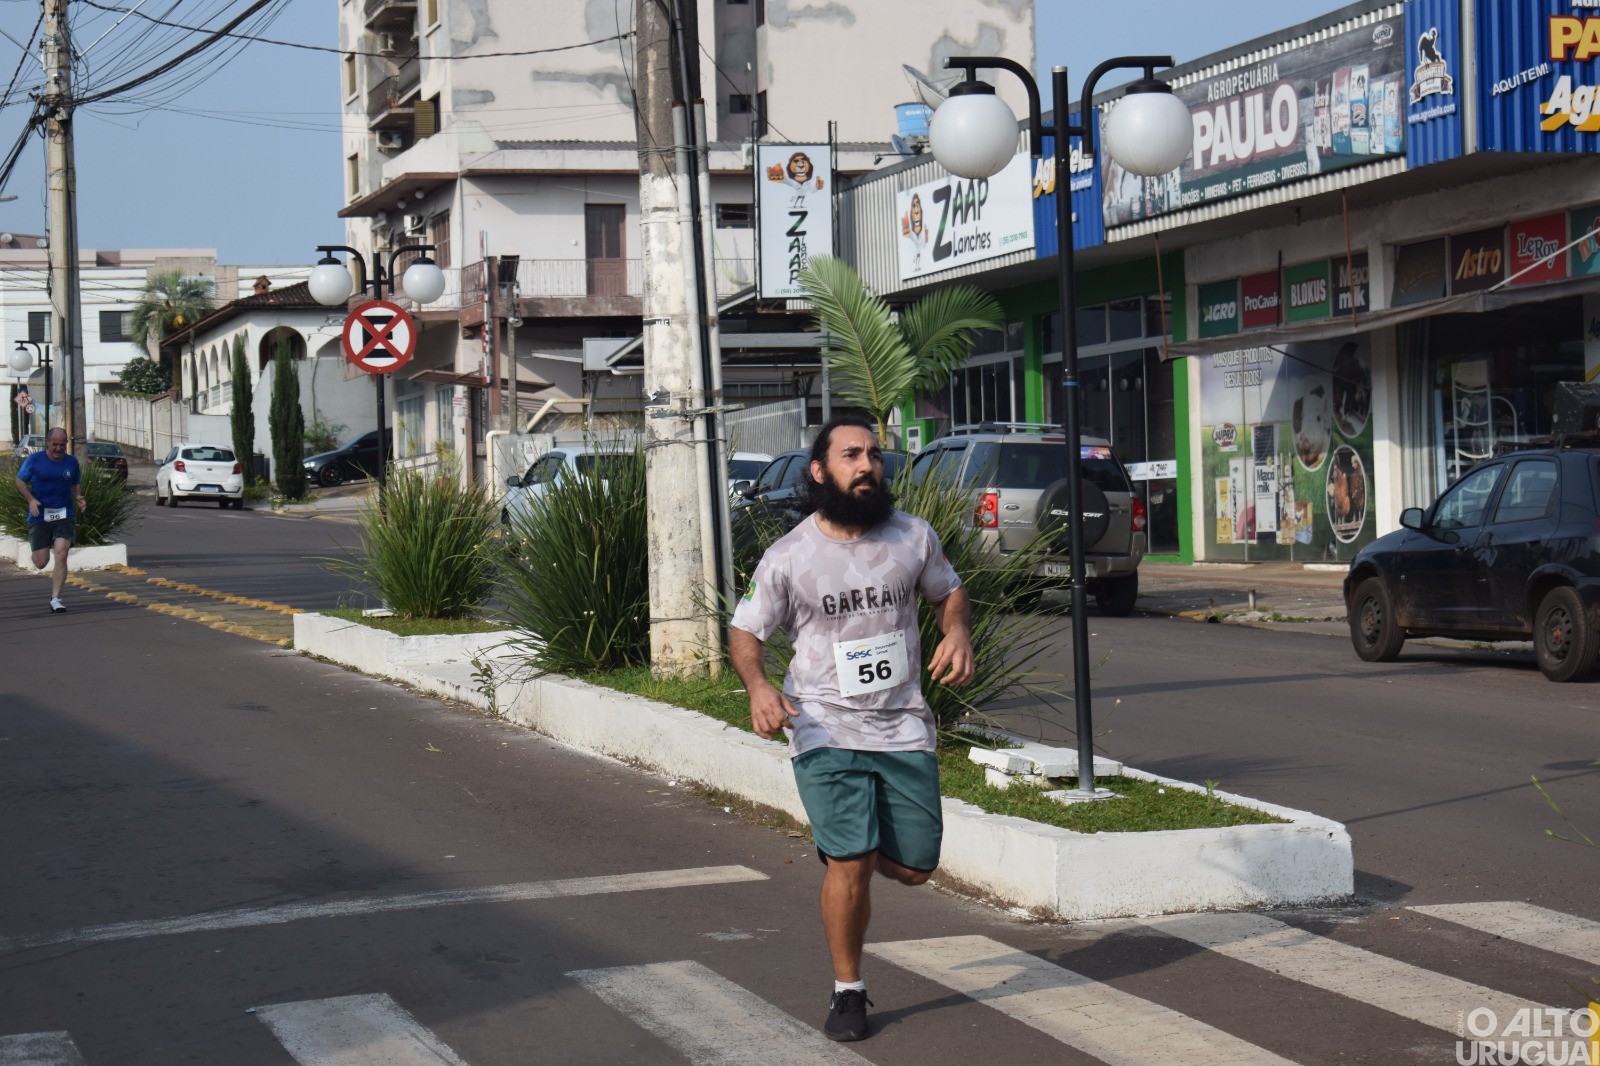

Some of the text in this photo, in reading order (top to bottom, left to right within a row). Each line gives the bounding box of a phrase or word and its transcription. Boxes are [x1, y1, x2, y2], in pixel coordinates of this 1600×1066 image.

[1549, 16, 1600, 61] PA
[1208, 63, 1279, 102] AGROPECUÁRIA
[1492, 62, 1549, 96] AQUI TEM!
[1192, 84, 1298, 170] PAULO
[1408, 103, 1456, 123] www.agrobella.com
[1205, 182, 1227, 200] MINERAIS
[1232, 178, 1242, 192] PET
[1247, 170, 1276, 188] FERRAGENS
[1282, 161, 1307, 180] DIVERSOS
[932, 178, 988, 262] ZAAP
[786, 211, 808, 285] ZAAP
[953, 226, 991, 258] Lanches
[1517, 232, 1558, 269] LeRoy
[1455, 247, 1501, 280] Astro
[1244, 291, 1280, 311] ProCaval
[1291, 279, 1326, 307] BLOKUS
[1204, 301, 1236, 322] AGRO
[1213, 352, 1226, 368] MAIS
[1227, 350, 1239, 366] QUE
[1257, 481, 1270, 493] milk
[822, 584, 893, 615] GARRA
[859, 660, 892, 684] 56
